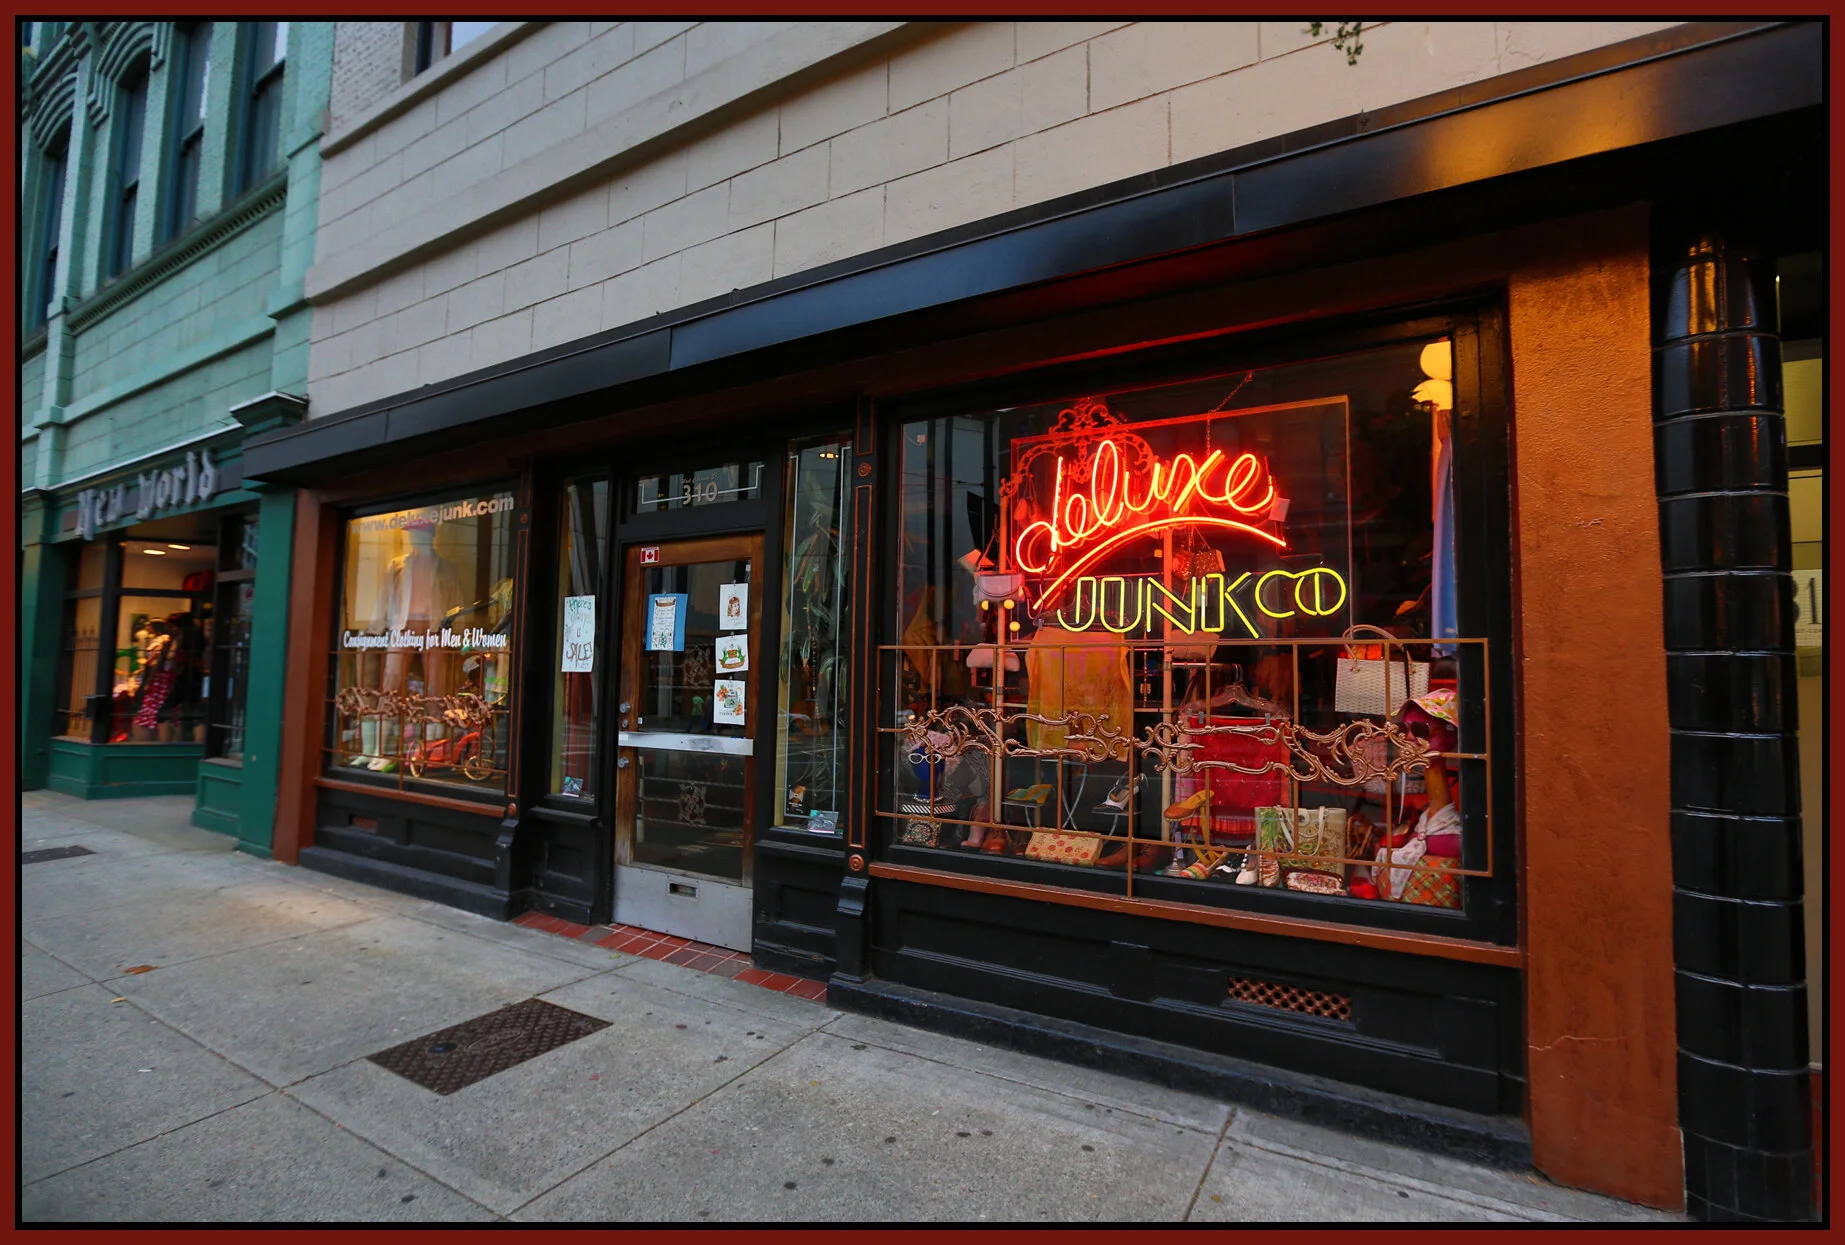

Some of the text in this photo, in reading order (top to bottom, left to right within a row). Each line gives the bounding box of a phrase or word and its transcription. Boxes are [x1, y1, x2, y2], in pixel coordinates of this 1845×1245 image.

[75, 449, 217, 540] New World
[682, 481, 718, 505] 310
[1015, 440, 1276, 573] deluxe
[350, 496, 514, 535] www.deluxejunk.com
[343, 627, 507, 651] Consignment Clothing for Men & Women
